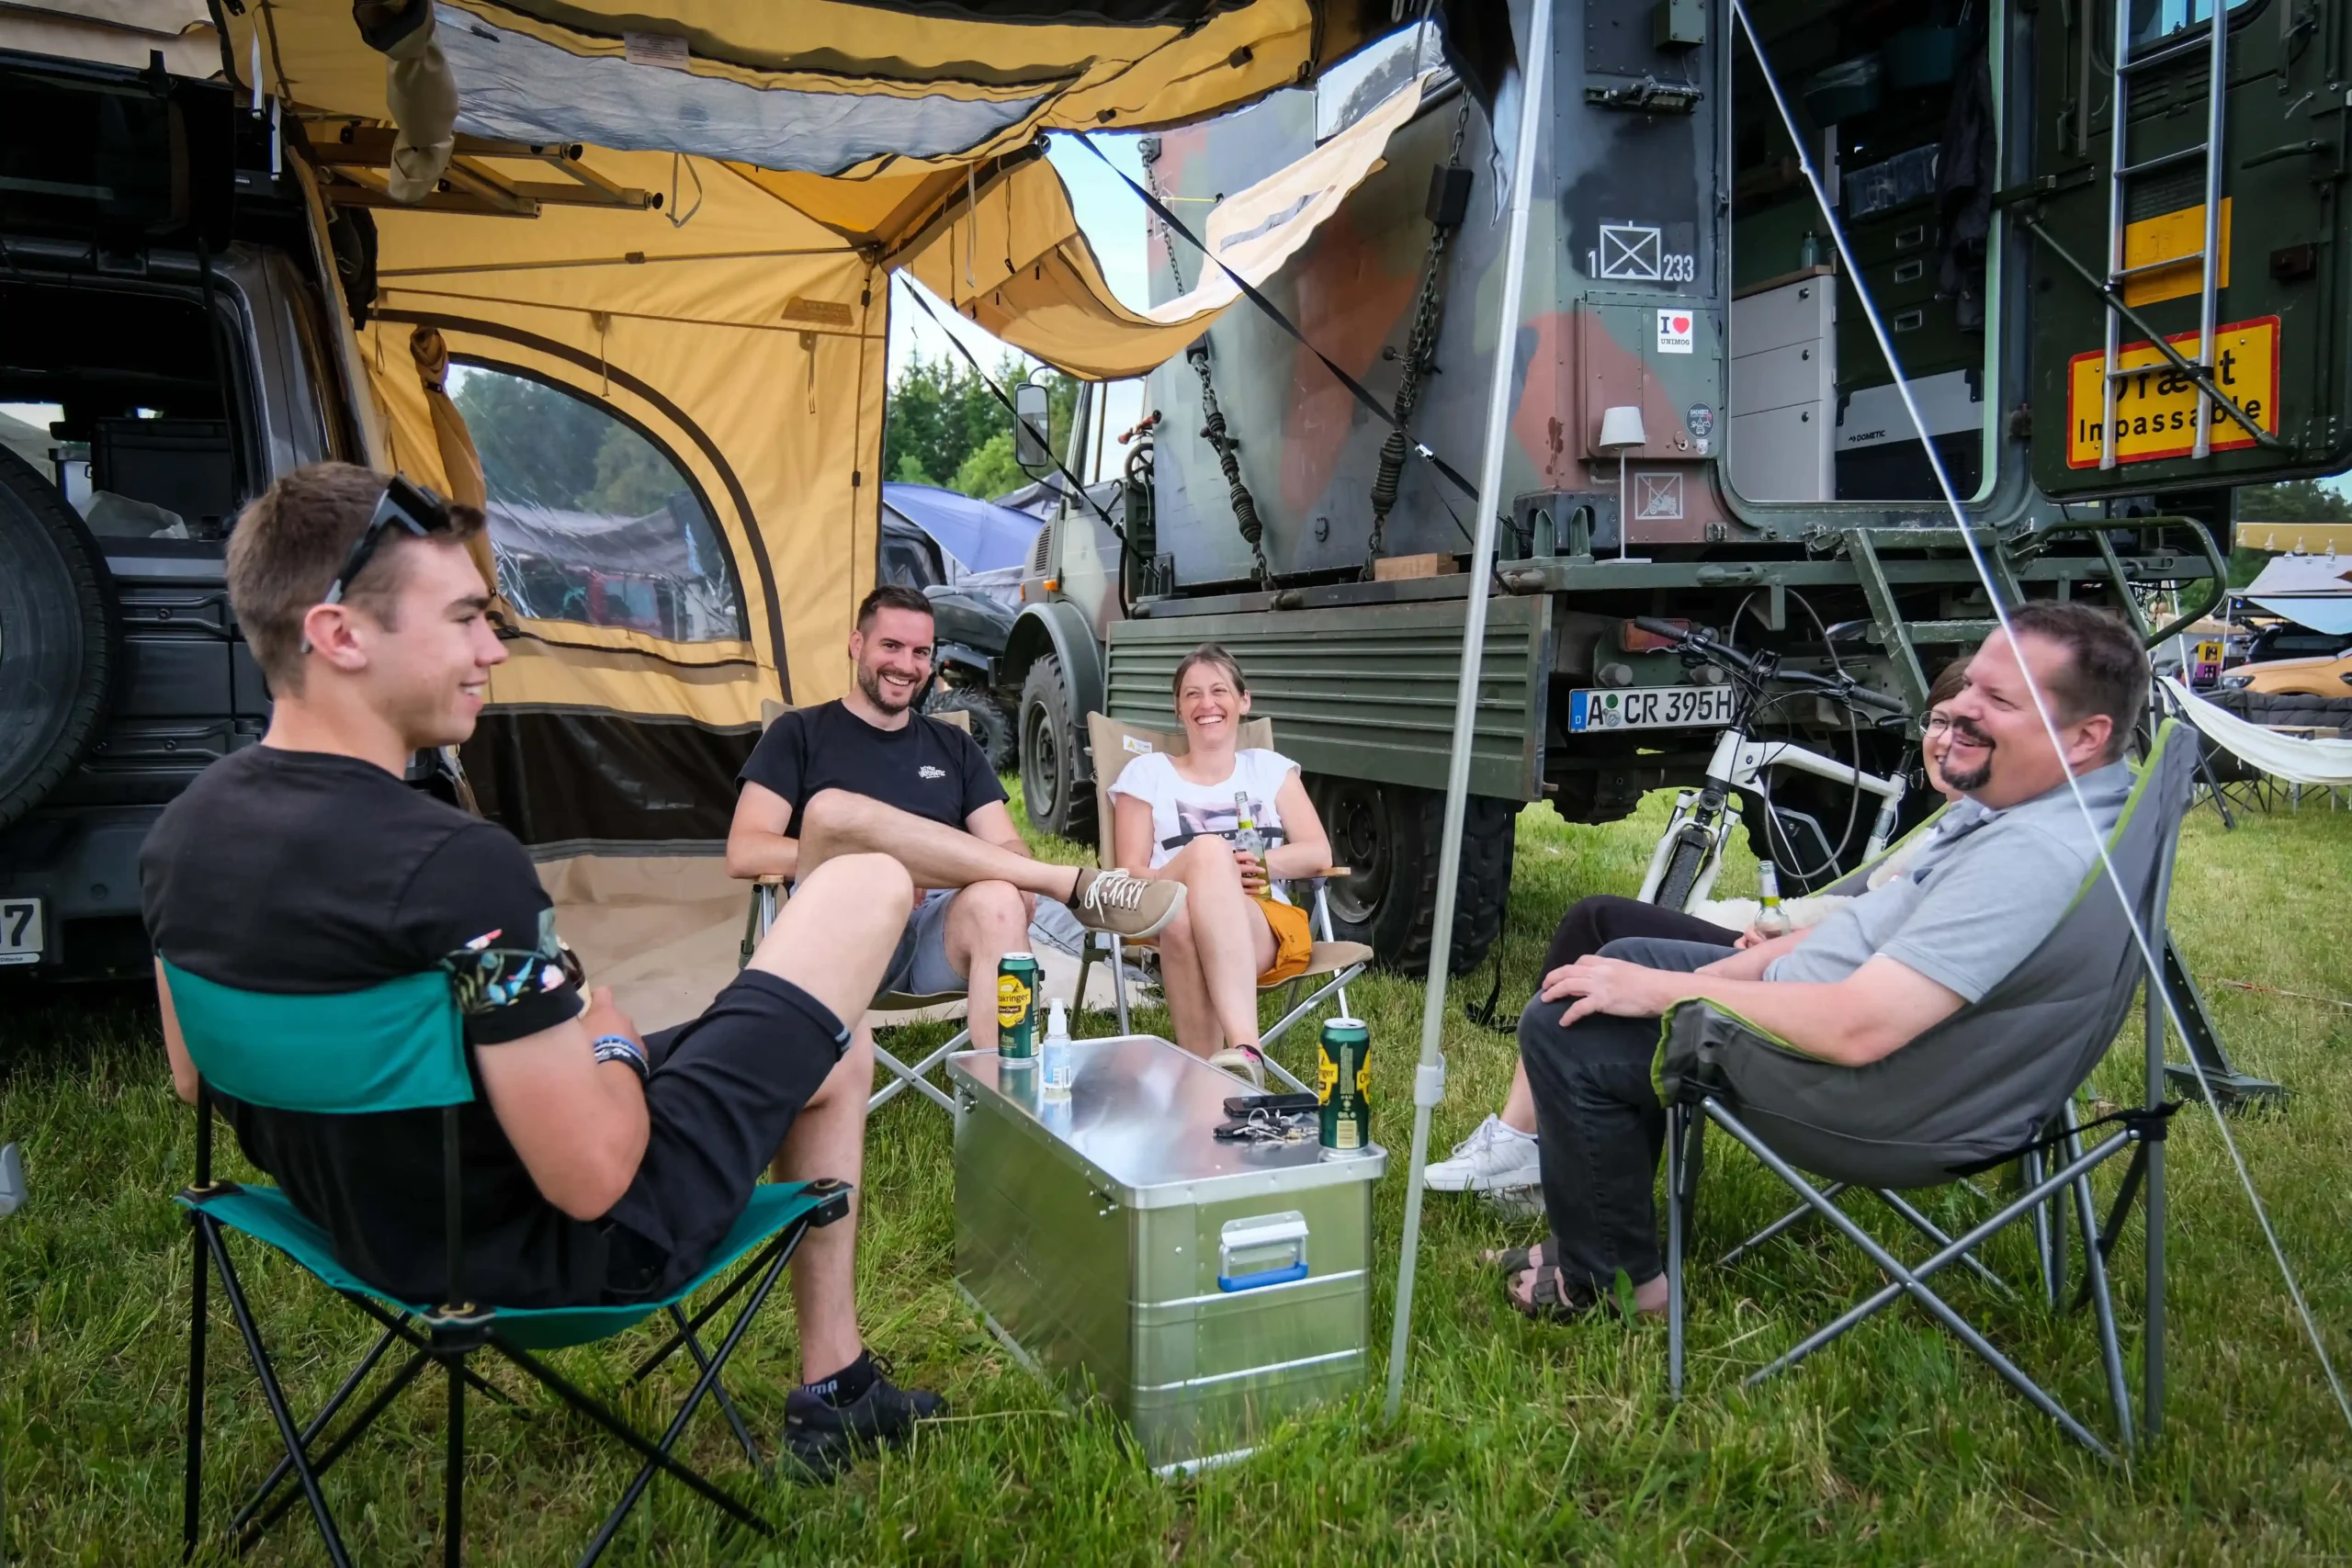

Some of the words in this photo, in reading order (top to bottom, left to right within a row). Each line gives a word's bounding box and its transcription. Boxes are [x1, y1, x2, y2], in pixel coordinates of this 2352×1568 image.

[1588, 250, 1596, 278] 1
[1663, 254, 1694, 282] 233
[1660, 316, 1670, 334] I
[1660, 338, 1690, 346] UNIMOG
[1857, 430, 1885, 442] DOMETIC
[1575, 715, 1582, 725] D
[1587, 694, 1604, 726] A
[1624, 693, 1658, 724] CR
[1665, 690, 1733, 723] 395H
